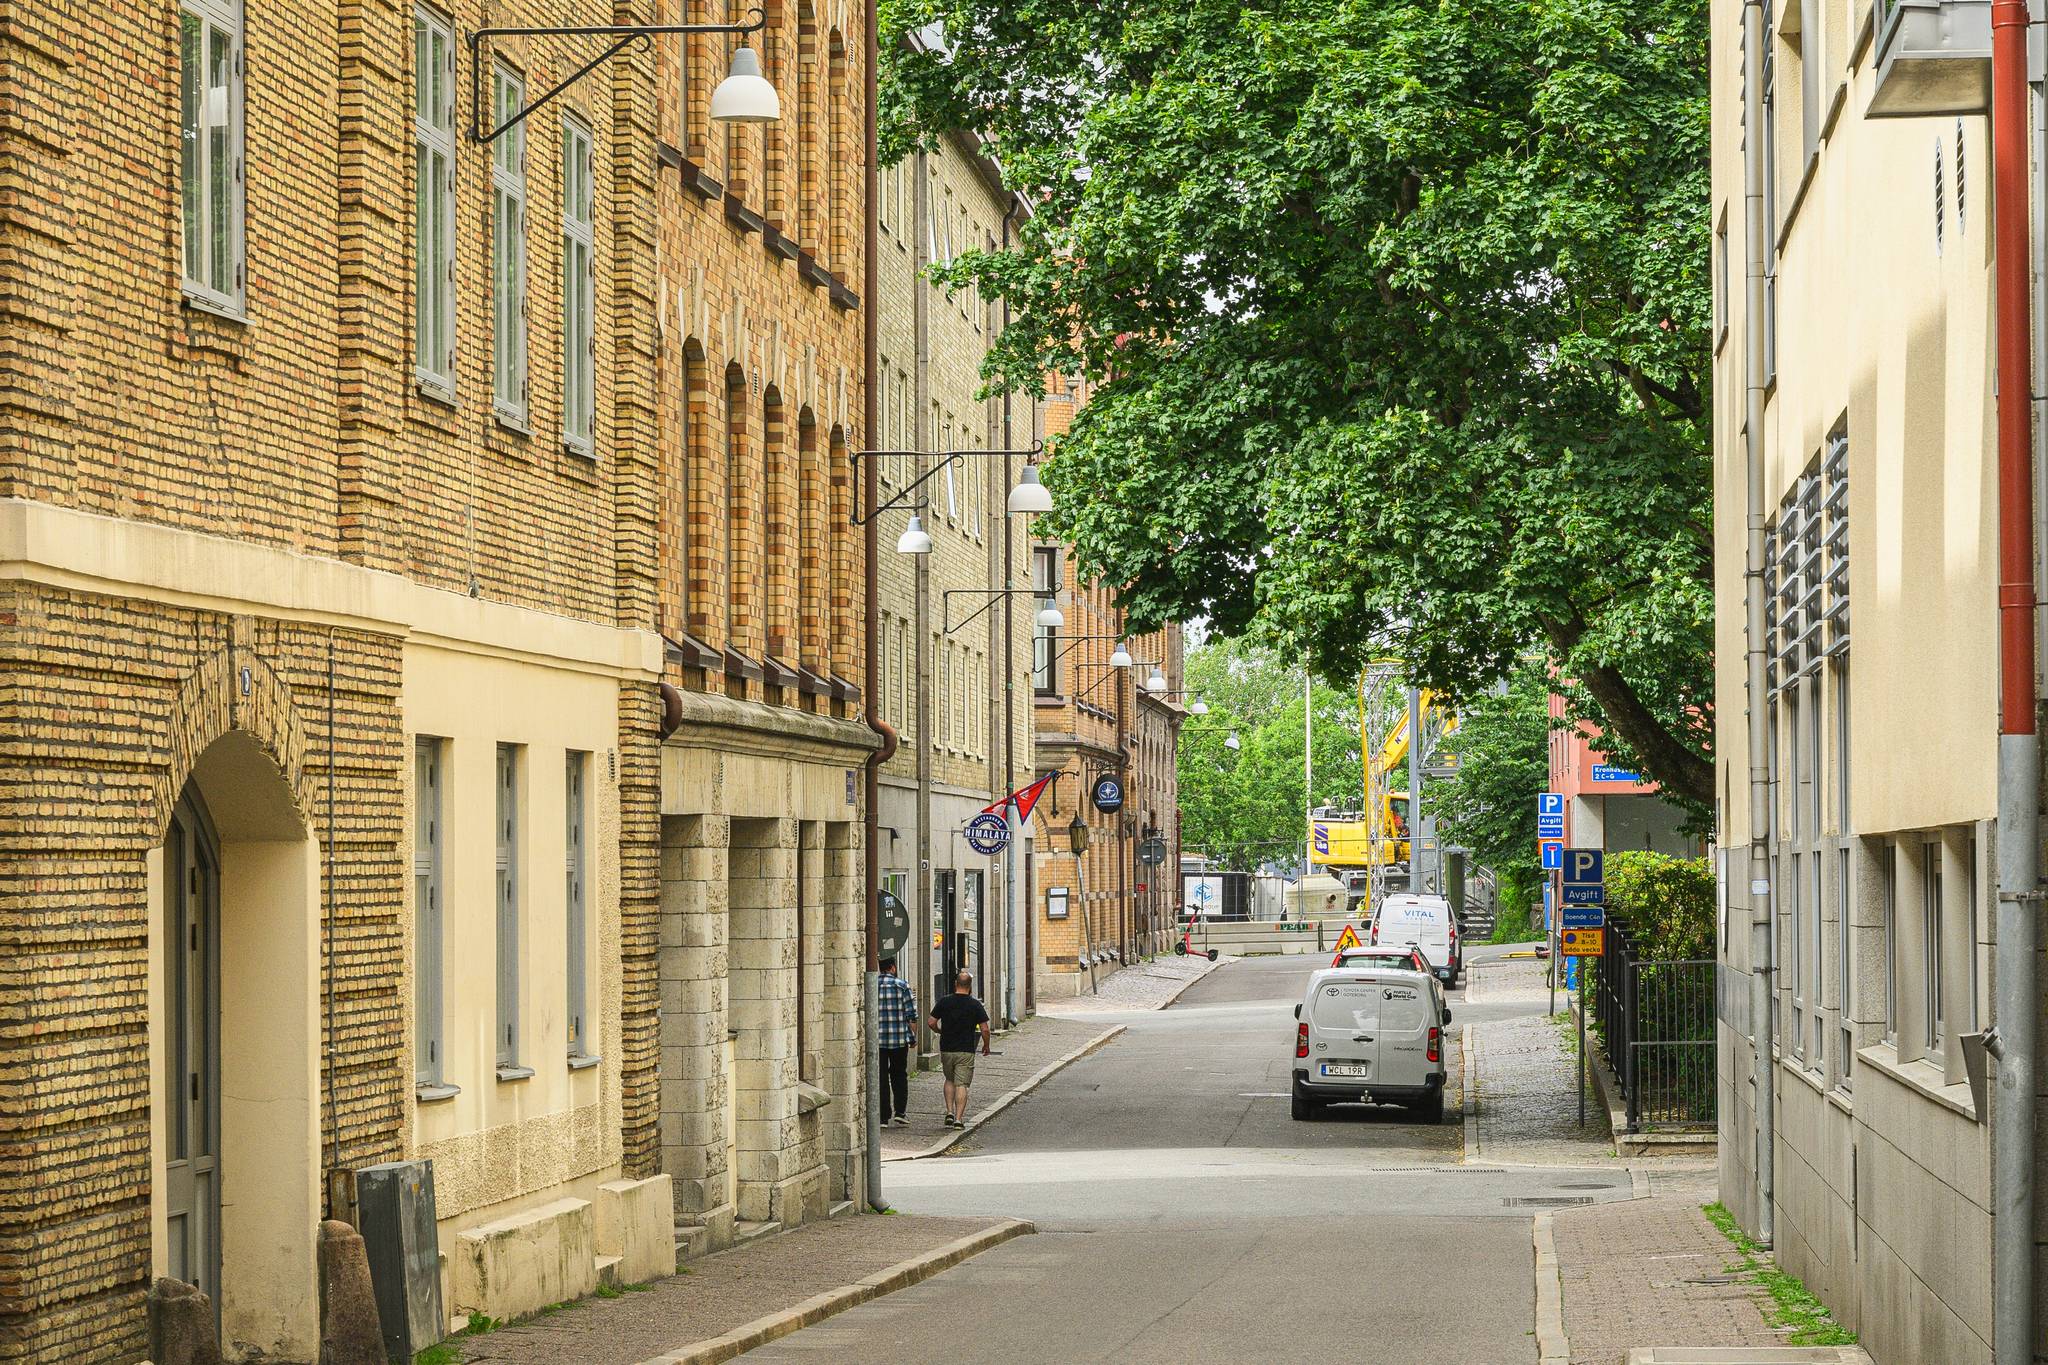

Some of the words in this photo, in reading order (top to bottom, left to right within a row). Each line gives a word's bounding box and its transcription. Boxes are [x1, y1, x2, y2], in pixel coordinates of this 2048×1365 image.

[1545, 795, 1558, 813] P
[1541, 817, 1561, 825] Avgift
[965, 828, 1010, 840] HIMALAYA
[922, 861, 928, 870] D
[1575, 852, 1594, 881] P
[1568, 890, 1598, 901] Avgift
[1404, 910, 1435, 918] VITAL
[1328, 1066, 1344, 1075] WCL
[1348, 1067, 1363, 1075] 19R
